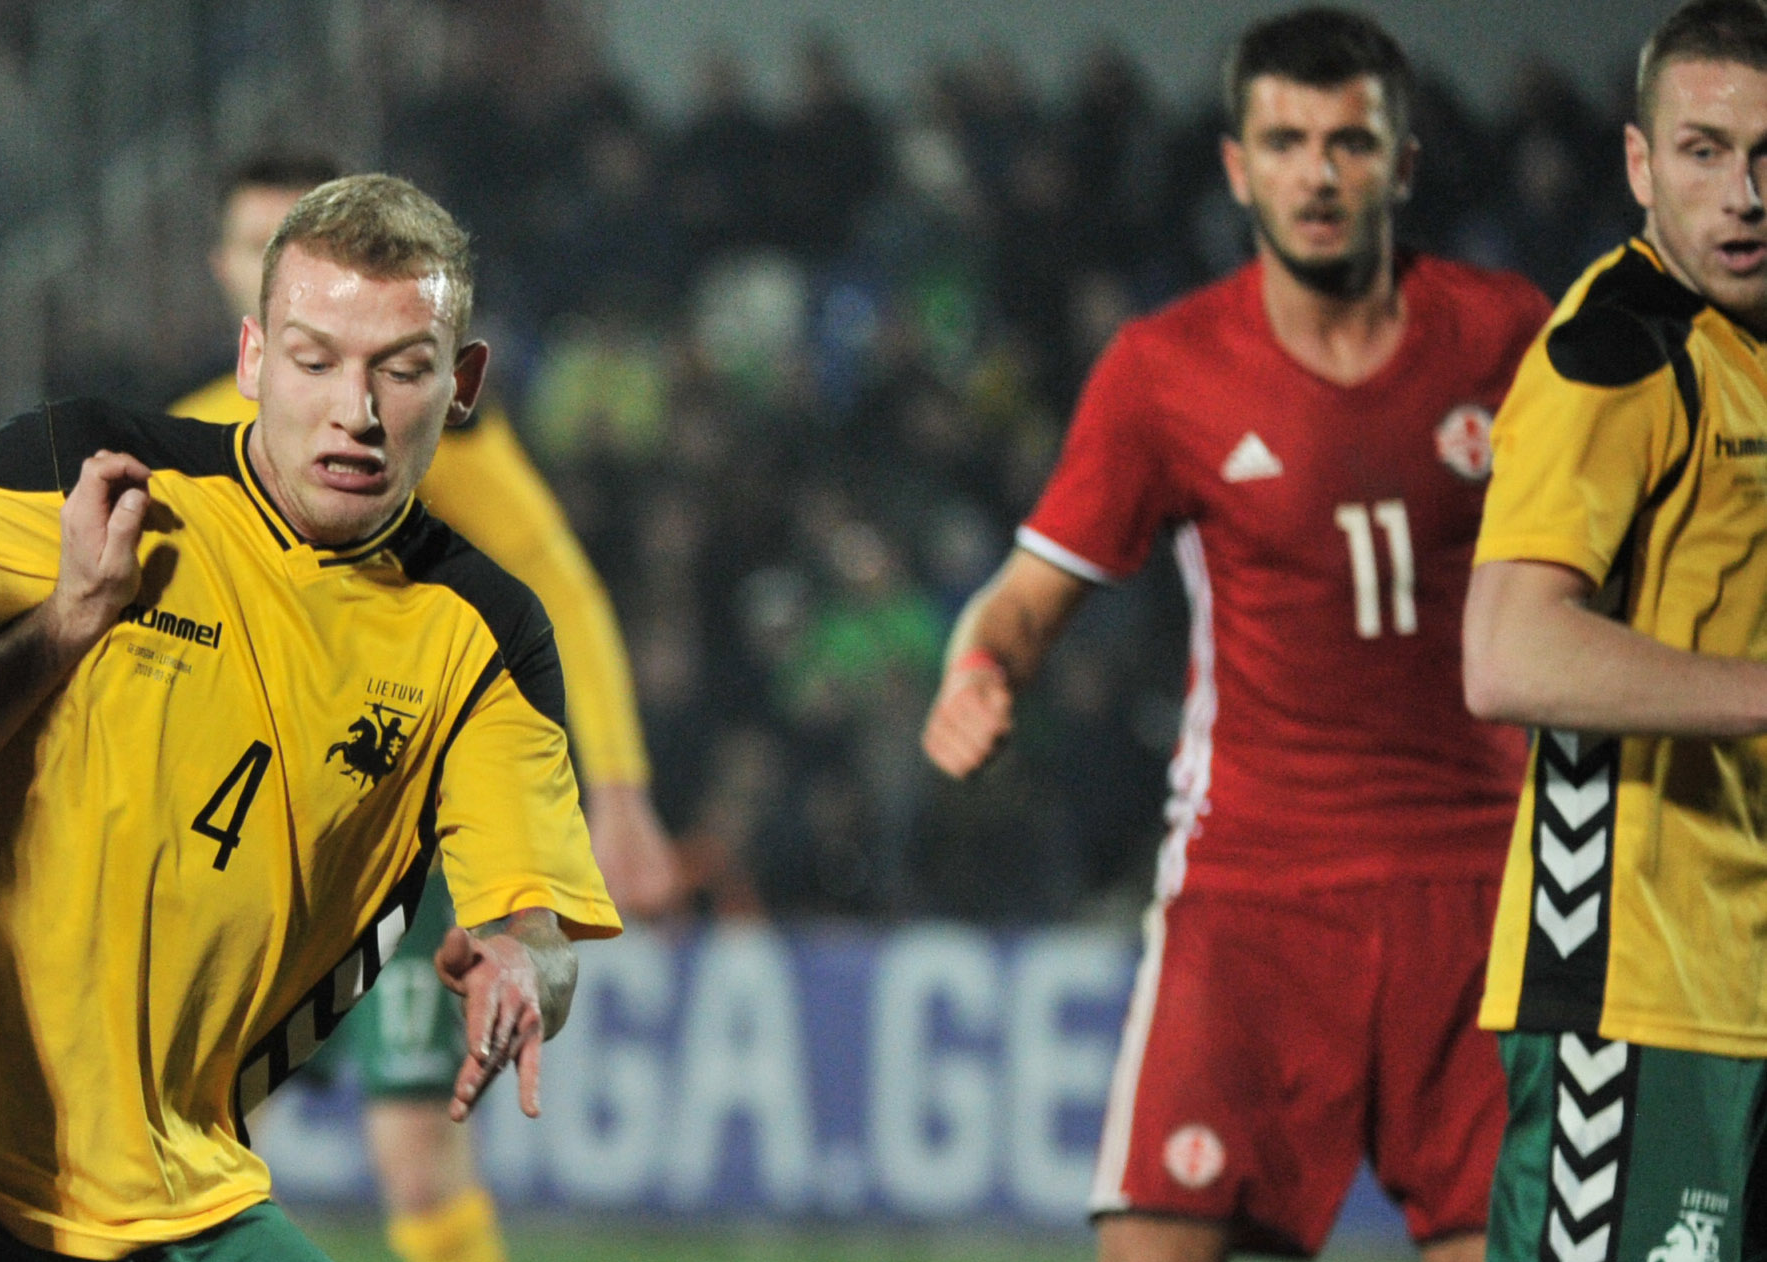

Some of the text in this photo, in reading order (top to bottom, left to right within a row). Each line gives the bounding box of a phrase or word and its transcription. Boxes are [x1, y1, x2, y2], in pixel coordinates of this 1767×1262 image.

[1335, 499, 1418, 638] 11
[367, 677, 423, 705] LIETUVA
[190, 739, 273, 872] 4
